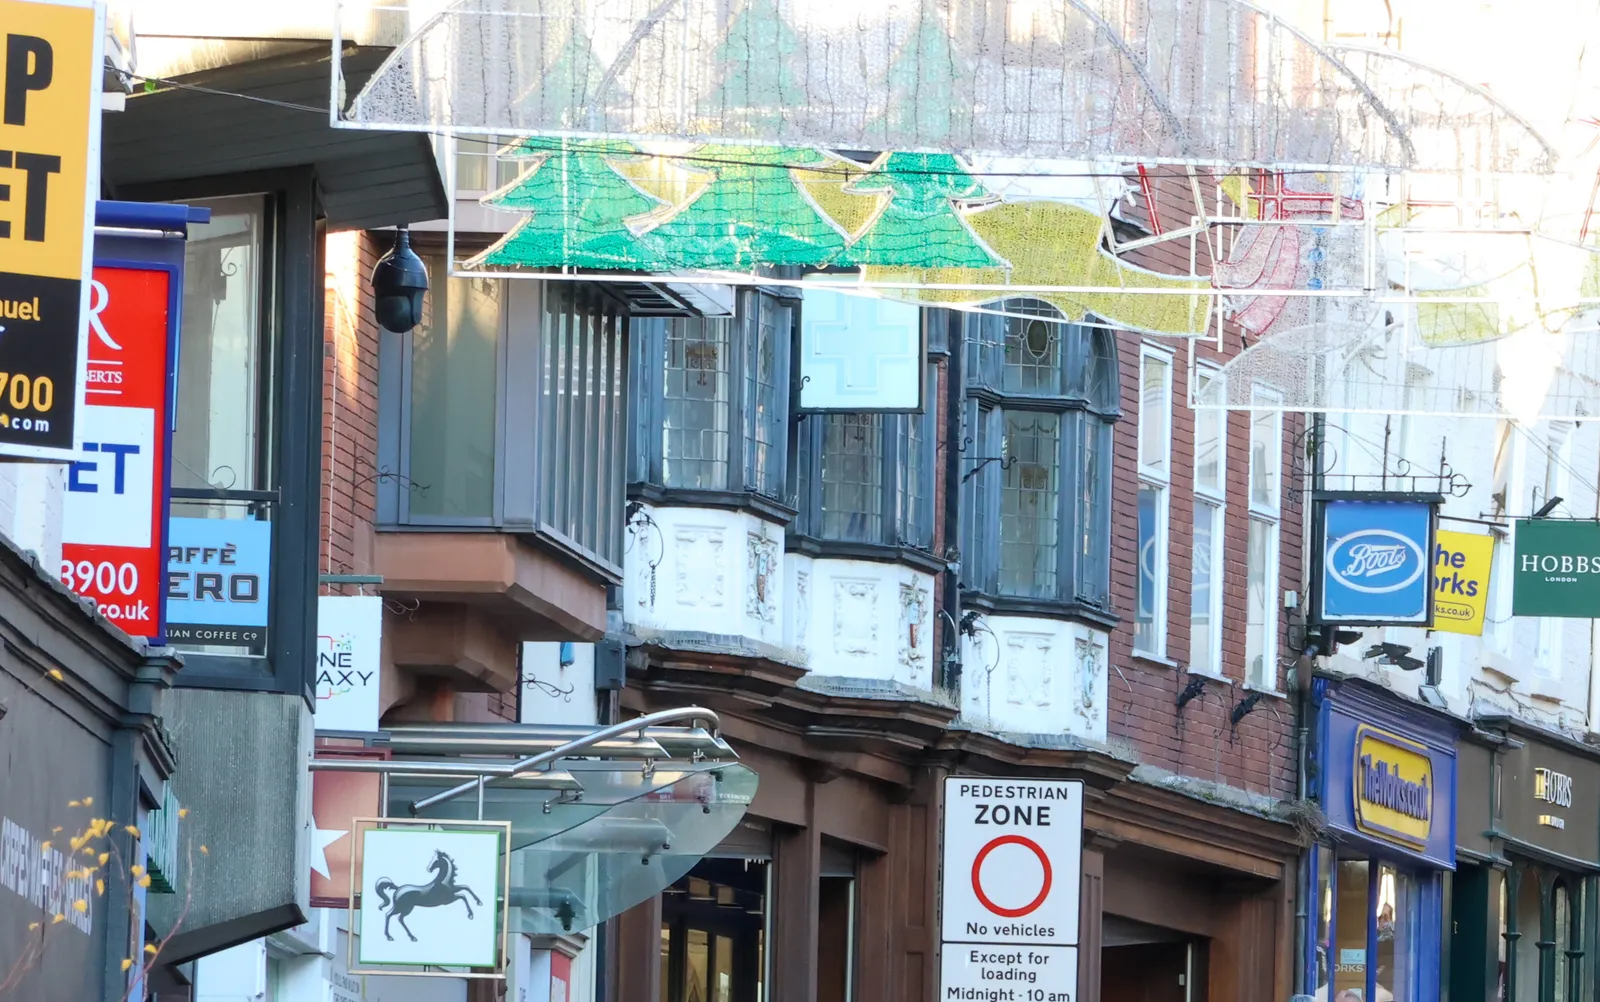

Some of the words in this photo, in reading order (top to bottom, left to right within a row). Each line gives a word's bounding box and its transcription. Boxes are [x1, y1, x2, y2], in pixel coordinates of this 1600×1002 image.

[168, 542, 237, 566] AFFÈ
[1340, 543, 1407, 577] Boots
[1435, 548, 1466, 568] he
[167, 571, 259, 603] ERO
[1434, 604, 1471, 618] ks.co.uk
[165, 629, 191, 638] LIAN
[195, 630, 238, 640] COFFEE
[316, 670, 374, 687] AXY
[960, 784, 1068, 800] PEDESTRIAN
[1534, 767, 1573, 808] HOBBS
[974, 804, 1051, 827] ZONE
[966, 922, 988, 935] No
[993, 923, 1055, 937] vehicles
[970, 950, 1022, 966] Except
[1028, 952, 1050, 965] for
[981, 967, 1037, 983] loading
[1334, 964, 1364, 973] ORKS
[947, 987, 1014, 1002] Midnight
[1027, 989, 1044, 1002] 10
[1048, 993, 1070, 1002] am
